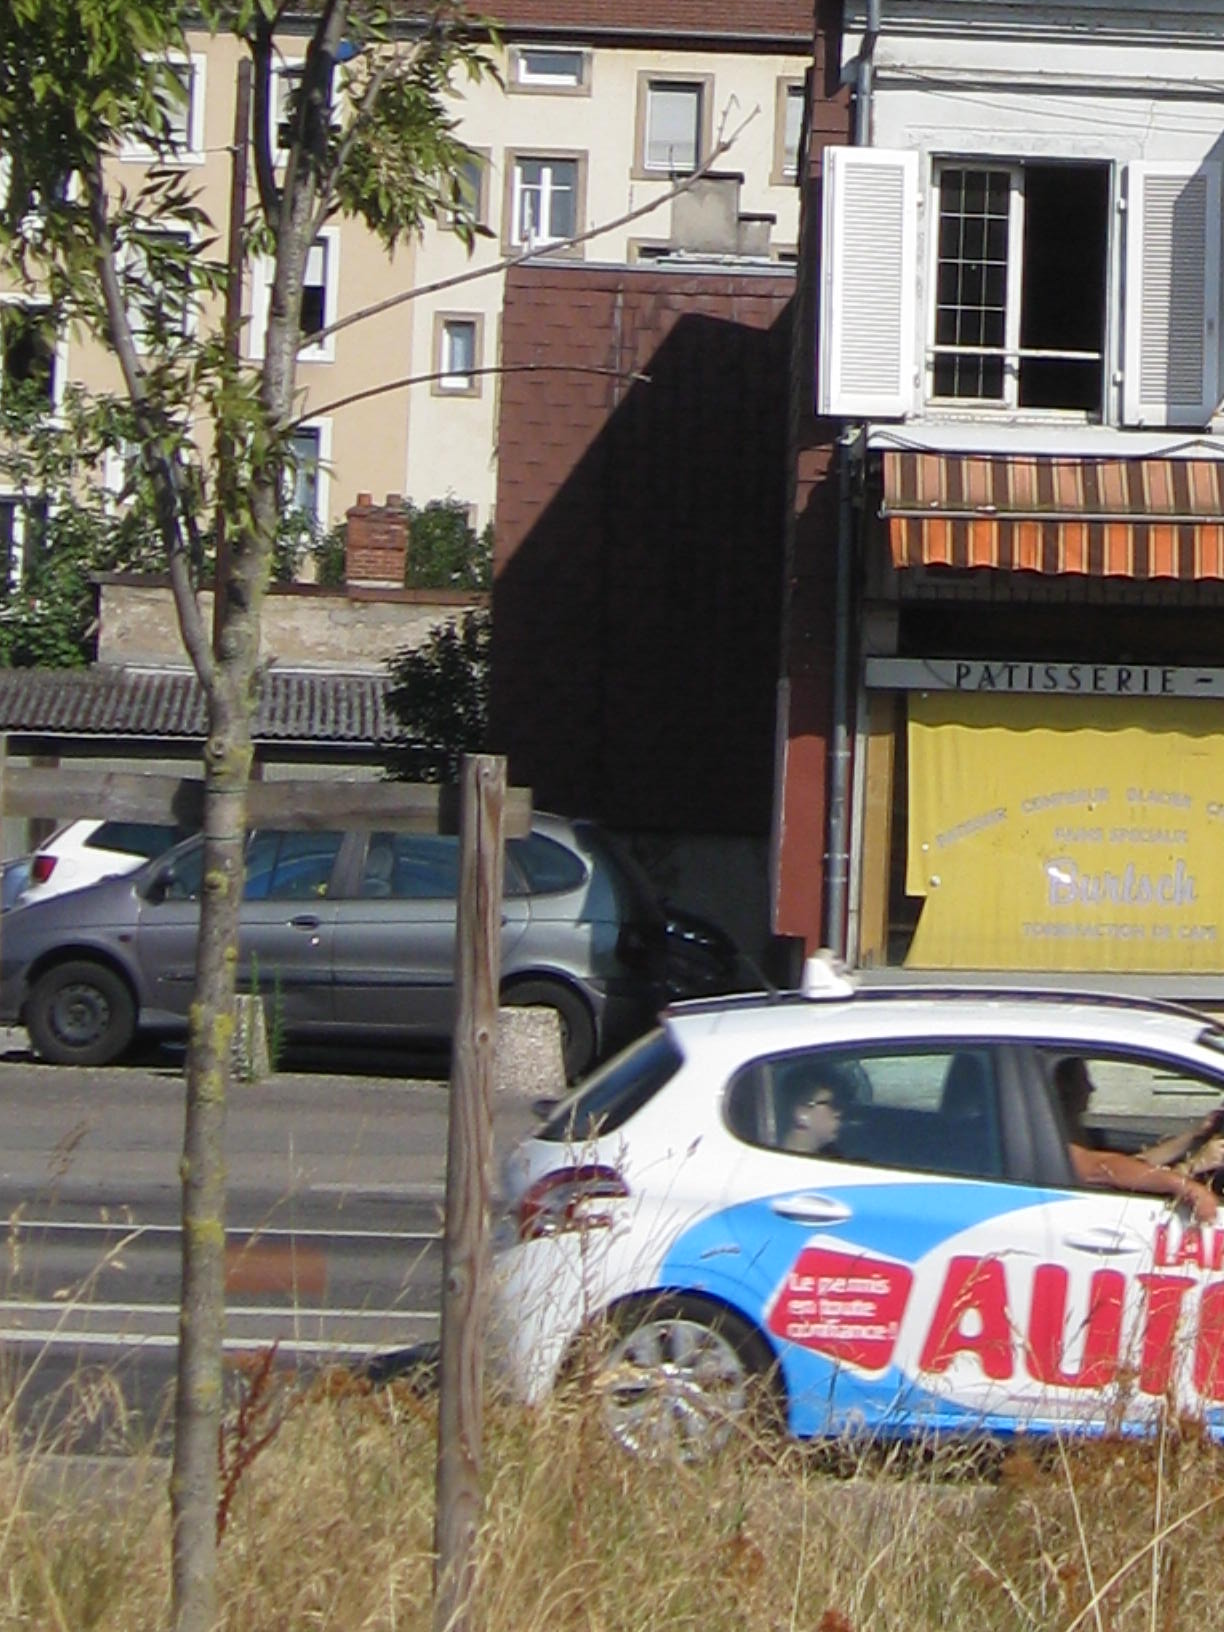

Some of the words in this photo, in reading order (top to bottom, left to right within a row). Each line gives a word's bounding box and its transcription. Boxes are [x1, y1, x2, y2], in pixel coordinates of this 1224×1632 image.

[955, 662, 1176, 695] PATISSERIE
[786, 1299, 817, 1315] en
[818, 1299, 878, 1317] toute
